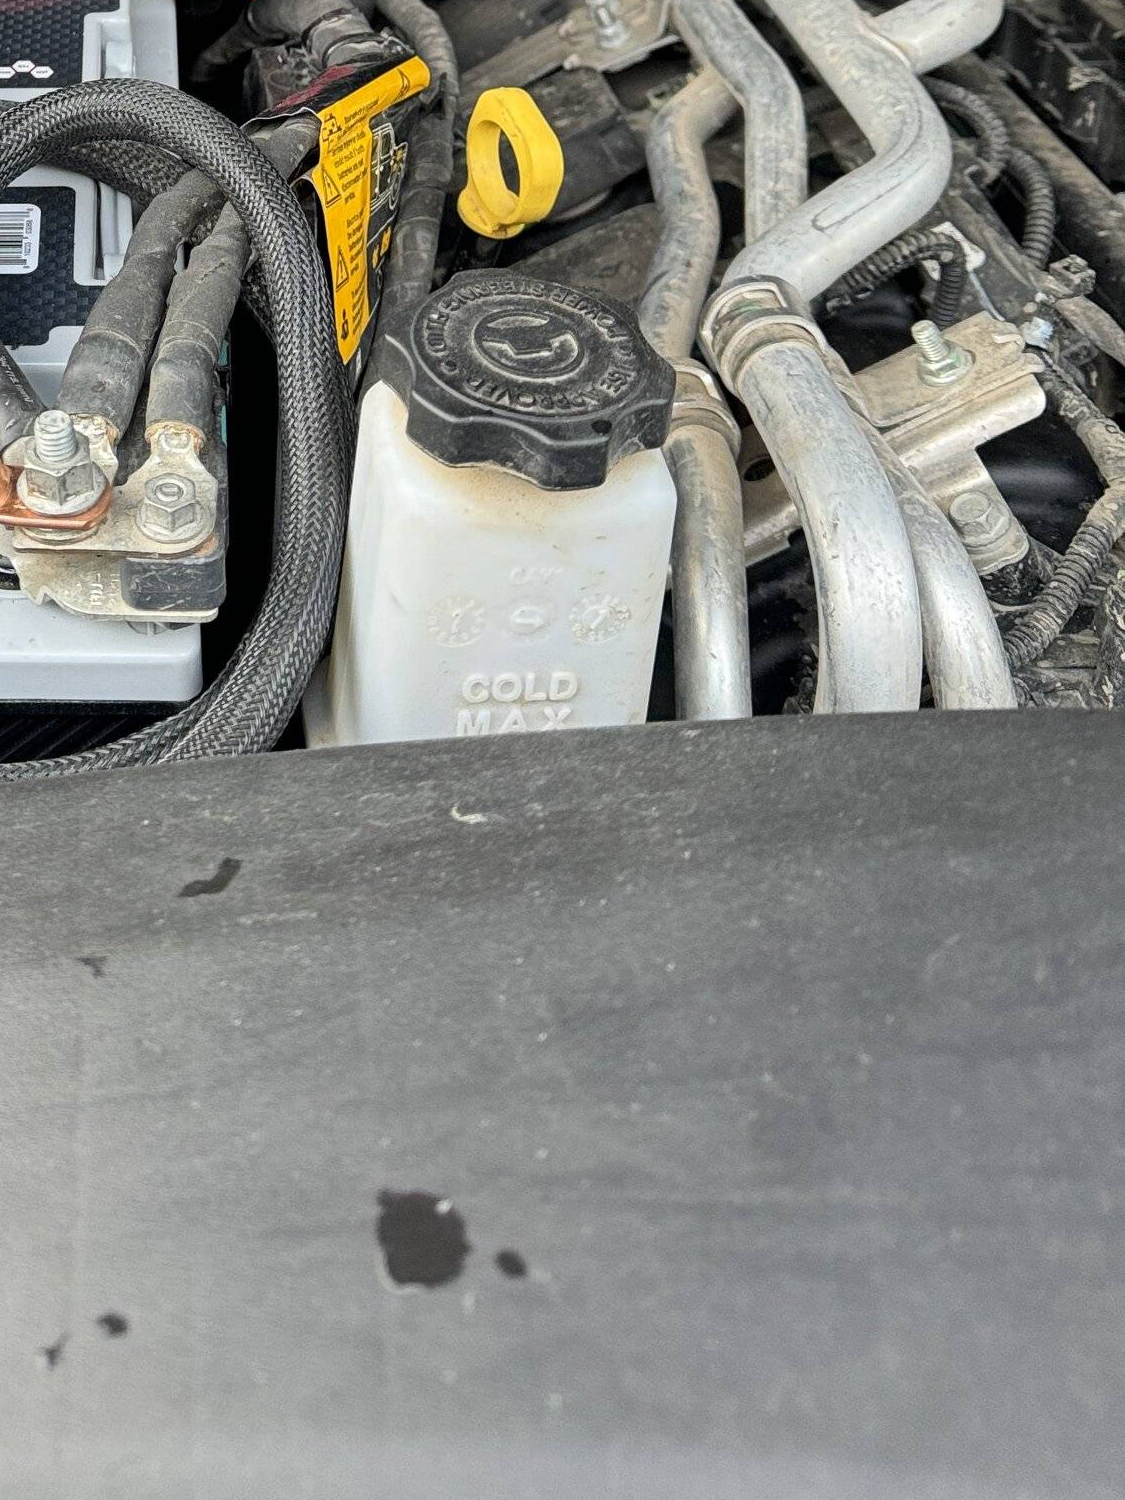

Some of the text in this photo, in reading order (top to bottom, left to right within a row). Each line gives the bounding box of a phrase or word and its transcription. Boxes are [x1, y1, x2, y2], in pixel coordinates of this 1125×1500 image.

[549, 289, 629, 341] POWER
[462, 671, 578, 703] COLD
[456, 705, 572, 737] MAX
